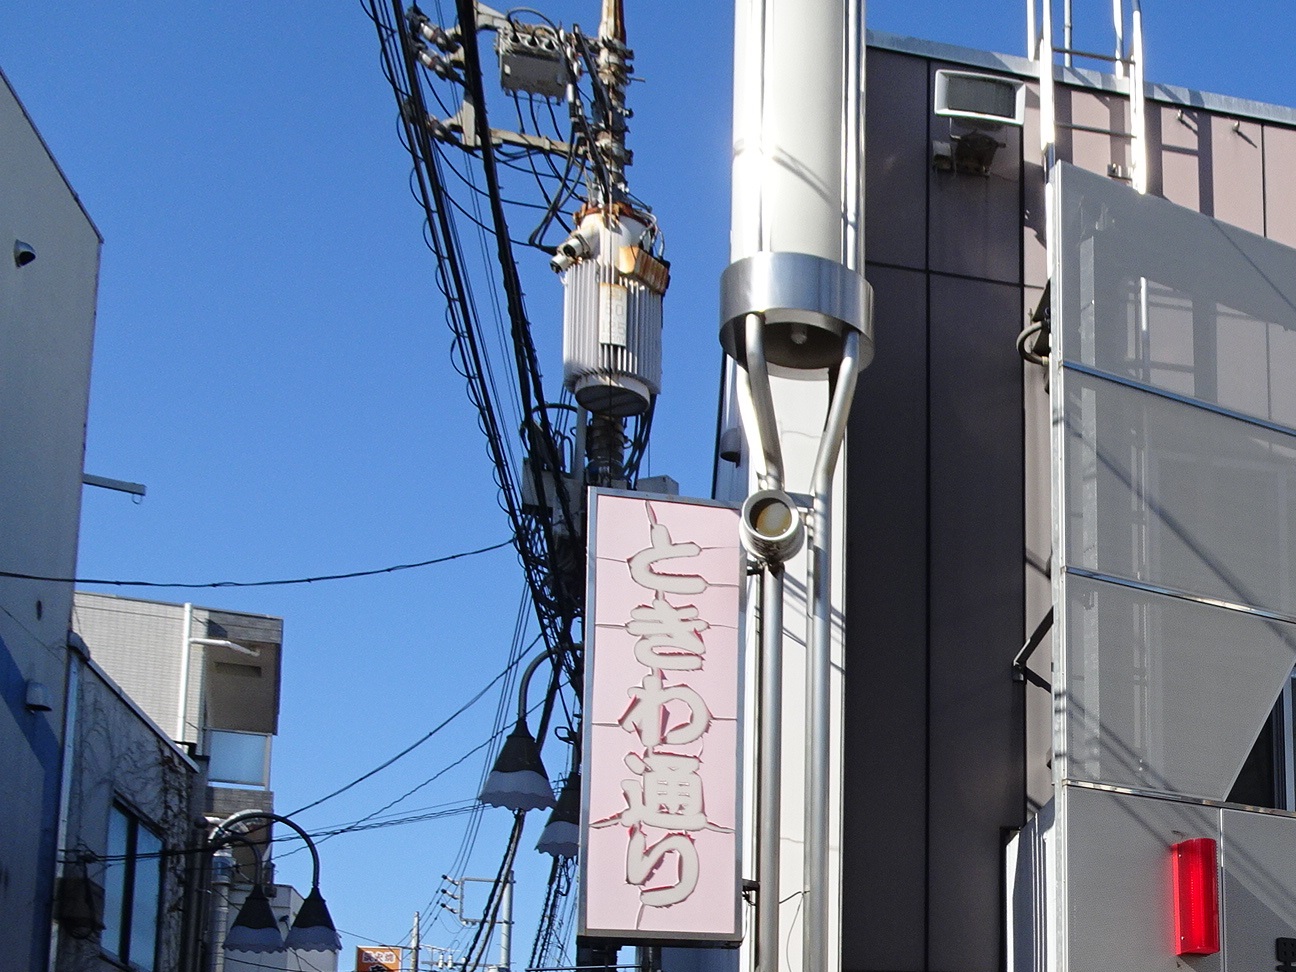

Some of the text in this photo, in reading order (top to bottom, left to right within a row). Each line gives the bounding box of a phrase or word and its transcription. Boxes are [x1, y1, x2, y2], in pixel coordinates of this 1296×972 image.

[617, 520, 712, 908] ときわ通り
